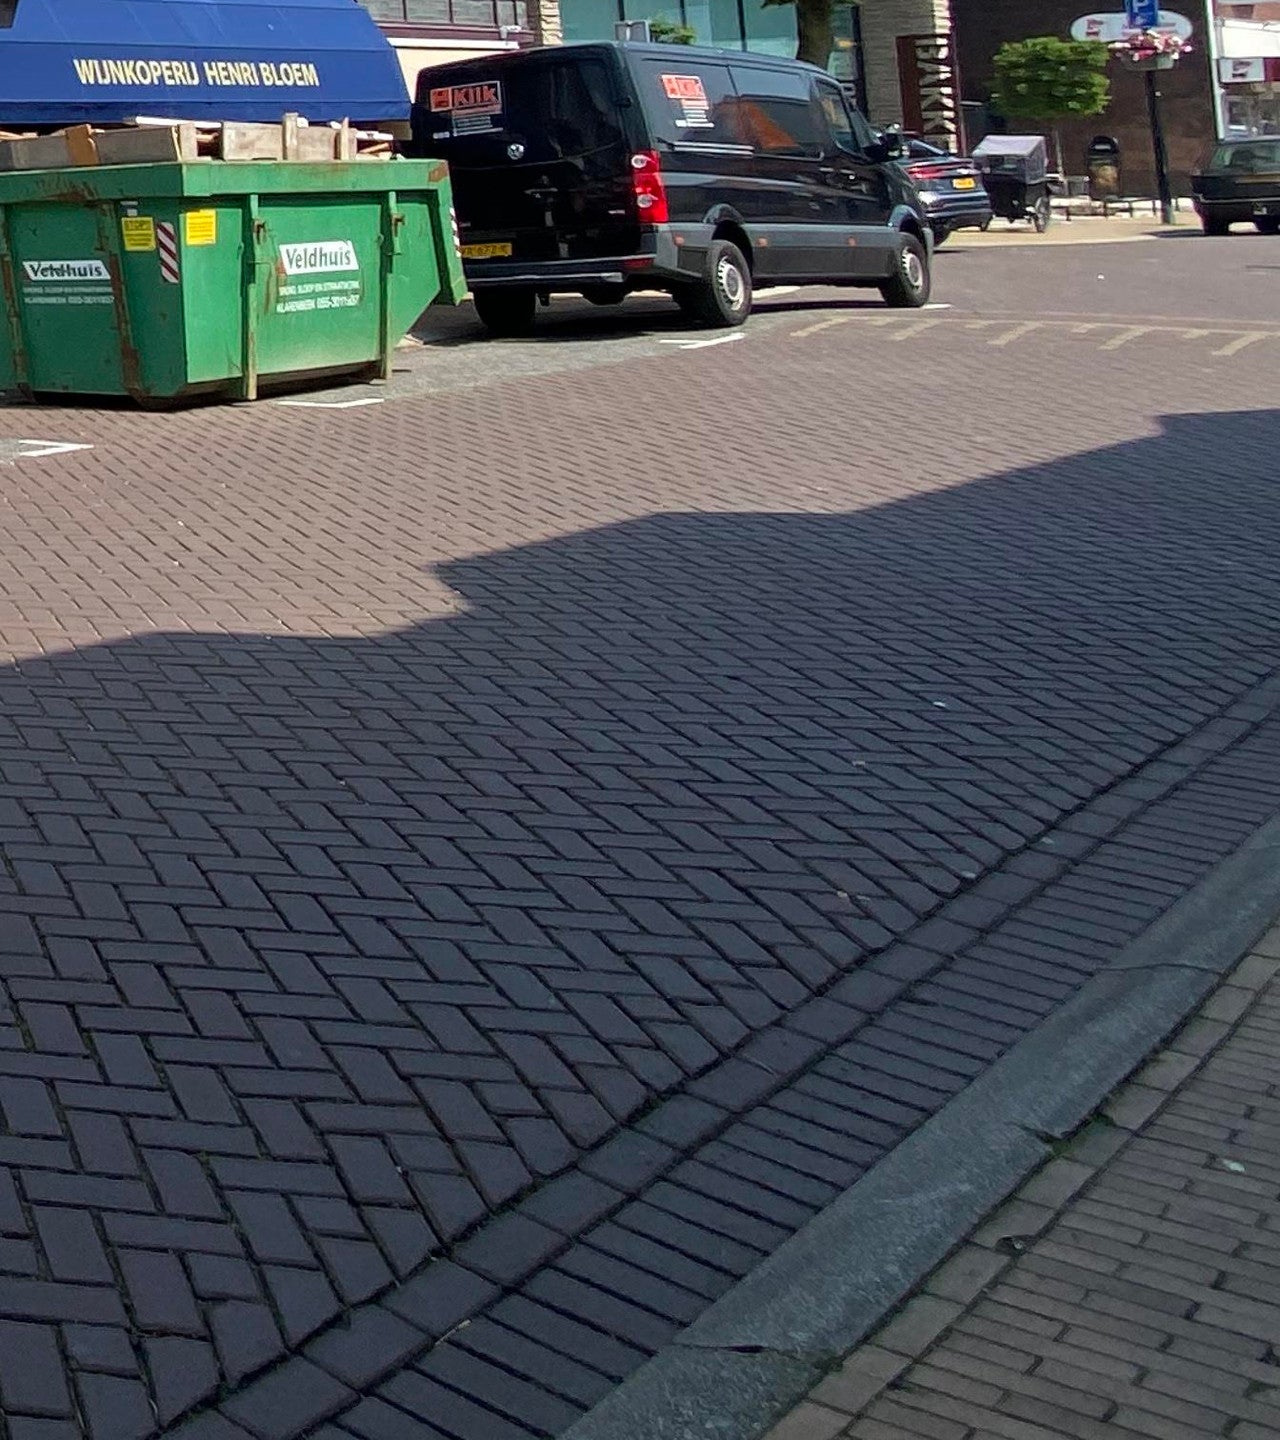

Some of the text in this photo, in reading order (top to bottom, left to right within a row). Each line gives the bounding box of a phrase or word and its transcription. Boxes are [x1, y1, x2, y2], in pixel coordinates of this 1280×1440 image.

[73, 60, 320, 86] WIJNKOPERIJ HENRI BLOEM
[286, 246, 352, 269] Veldhuis
